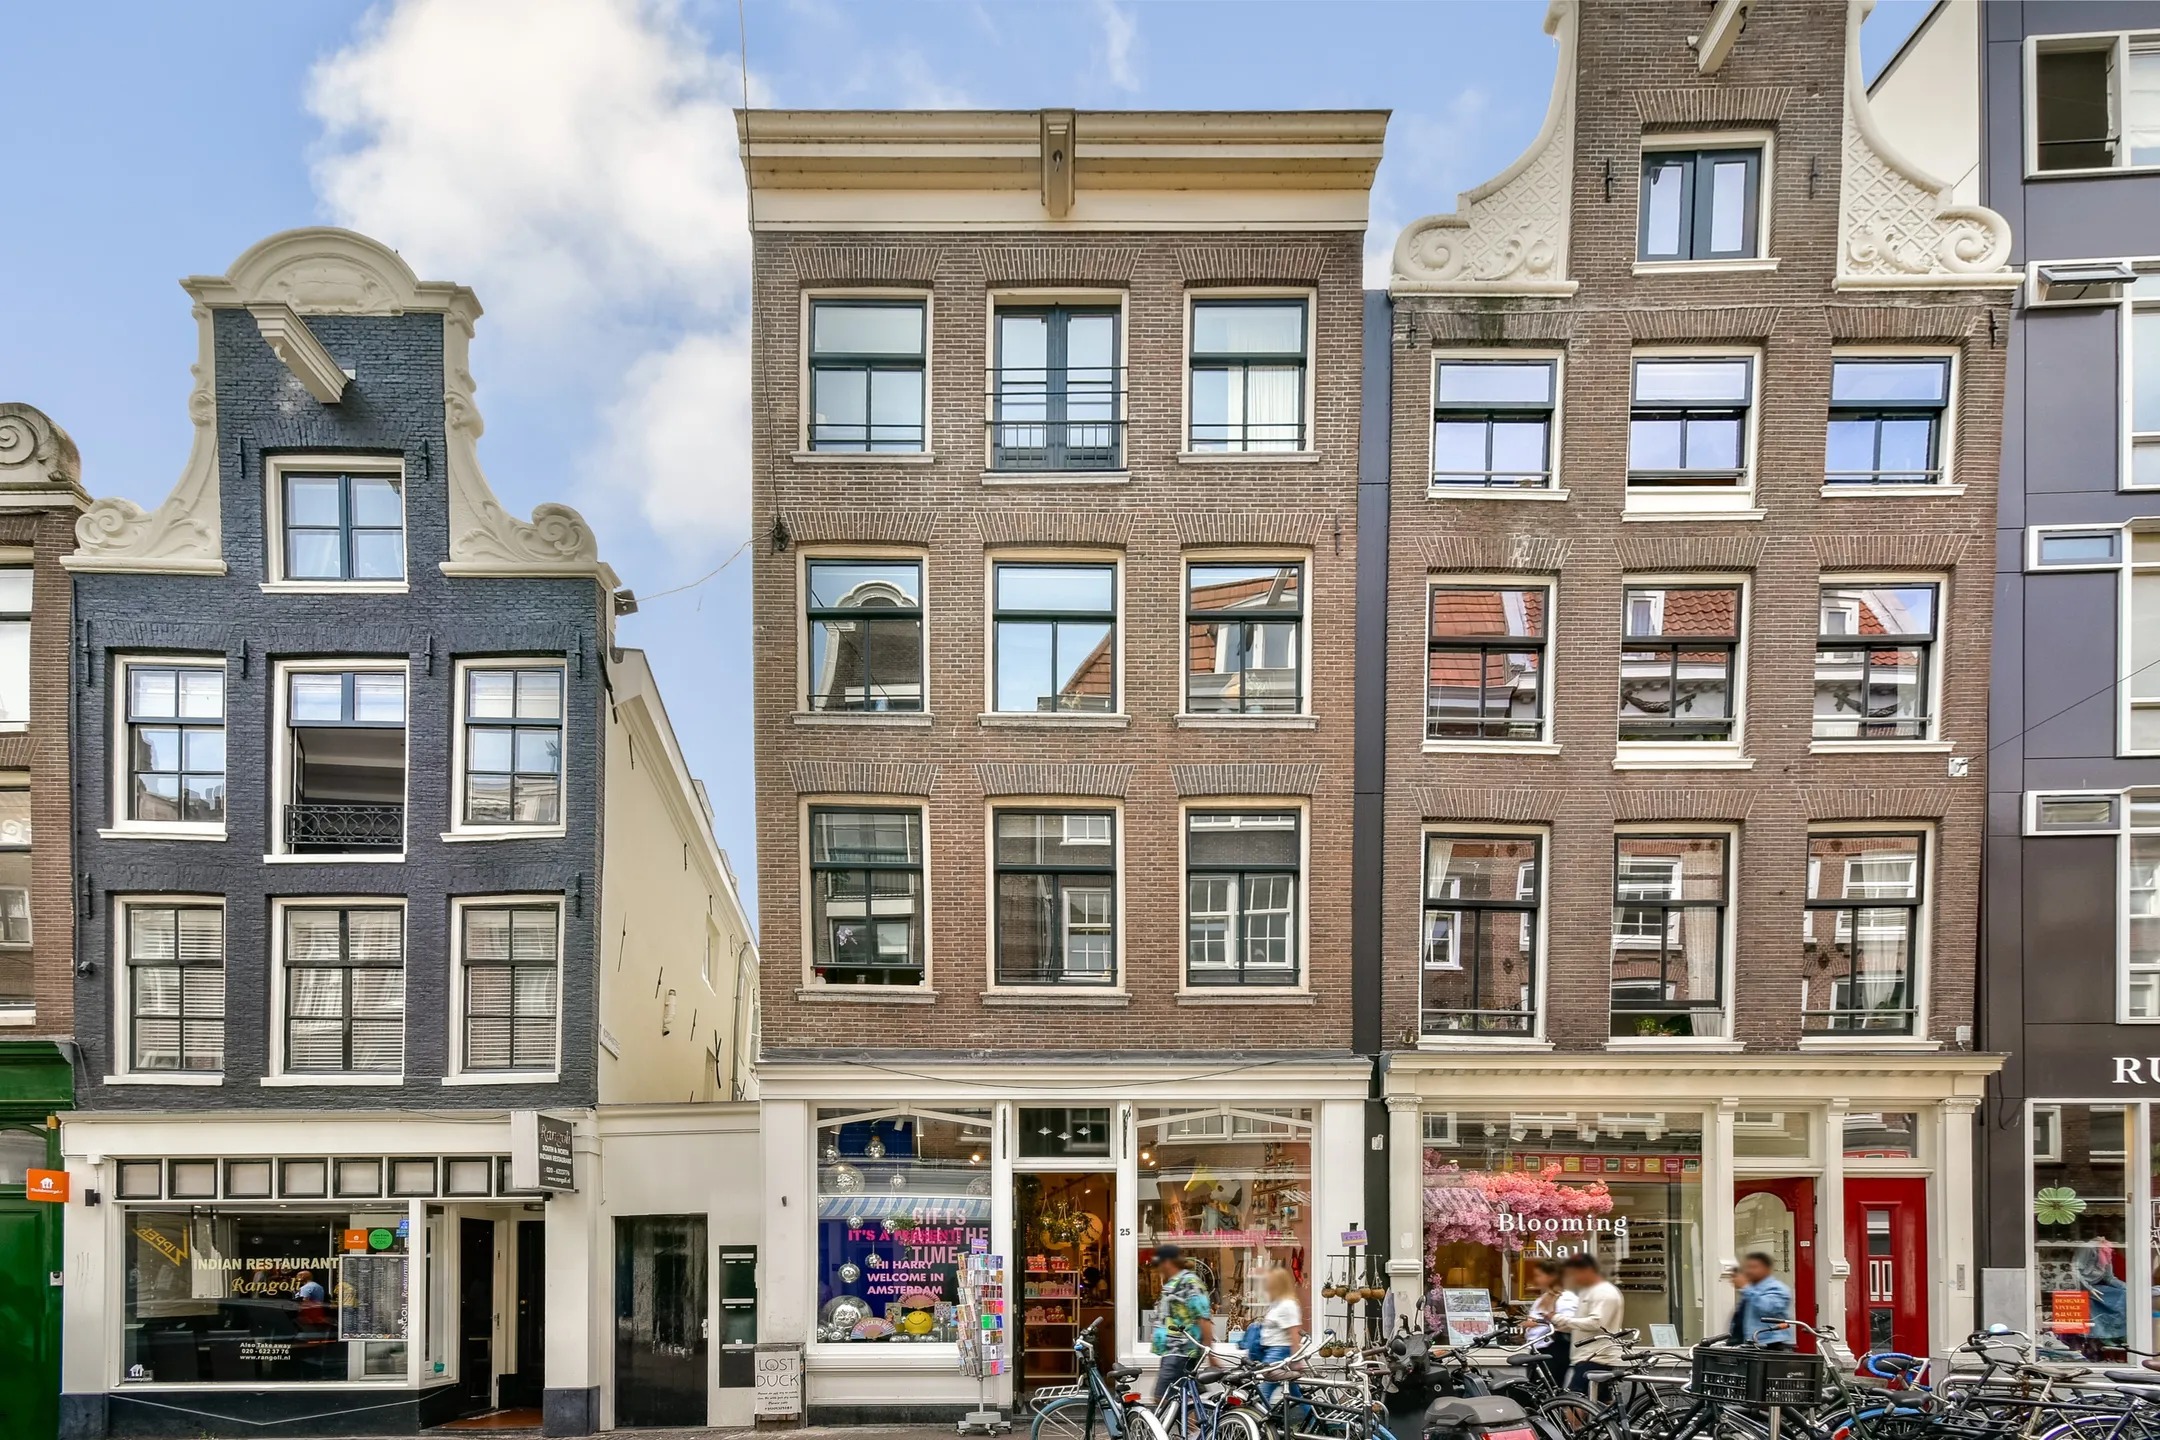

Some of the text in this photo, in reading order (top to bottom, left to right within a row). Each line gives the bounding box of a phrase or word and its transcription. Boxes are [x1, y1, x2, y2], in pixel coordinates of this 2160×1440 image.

[912, 1207, 966, 1225] GIFTS
[1498, 1213, 1627, 1237] Blooming
[848, 1229, 875, 1241] IT'S
[879, 1230, 891, 1241] A
[953, 1227, 989, 1245] THE
[1119, 1228, 1131, 1236] 25
[910, 1246, 958, 1264] TIME
[194, 1257, 340, 1270] INDIAN RESTAURANT
[876, 1261, 933, 1269] HI HARRY
[867, 1273, 944, 1282] WELCOME IN
[231, 1277, 302, 1295] Rangoli
[867, 1286, 943, 1295] AMSTERDAM
[759, 1358, 796, 1371] LOST
[757, 1374, 799, 1387] DUCK
